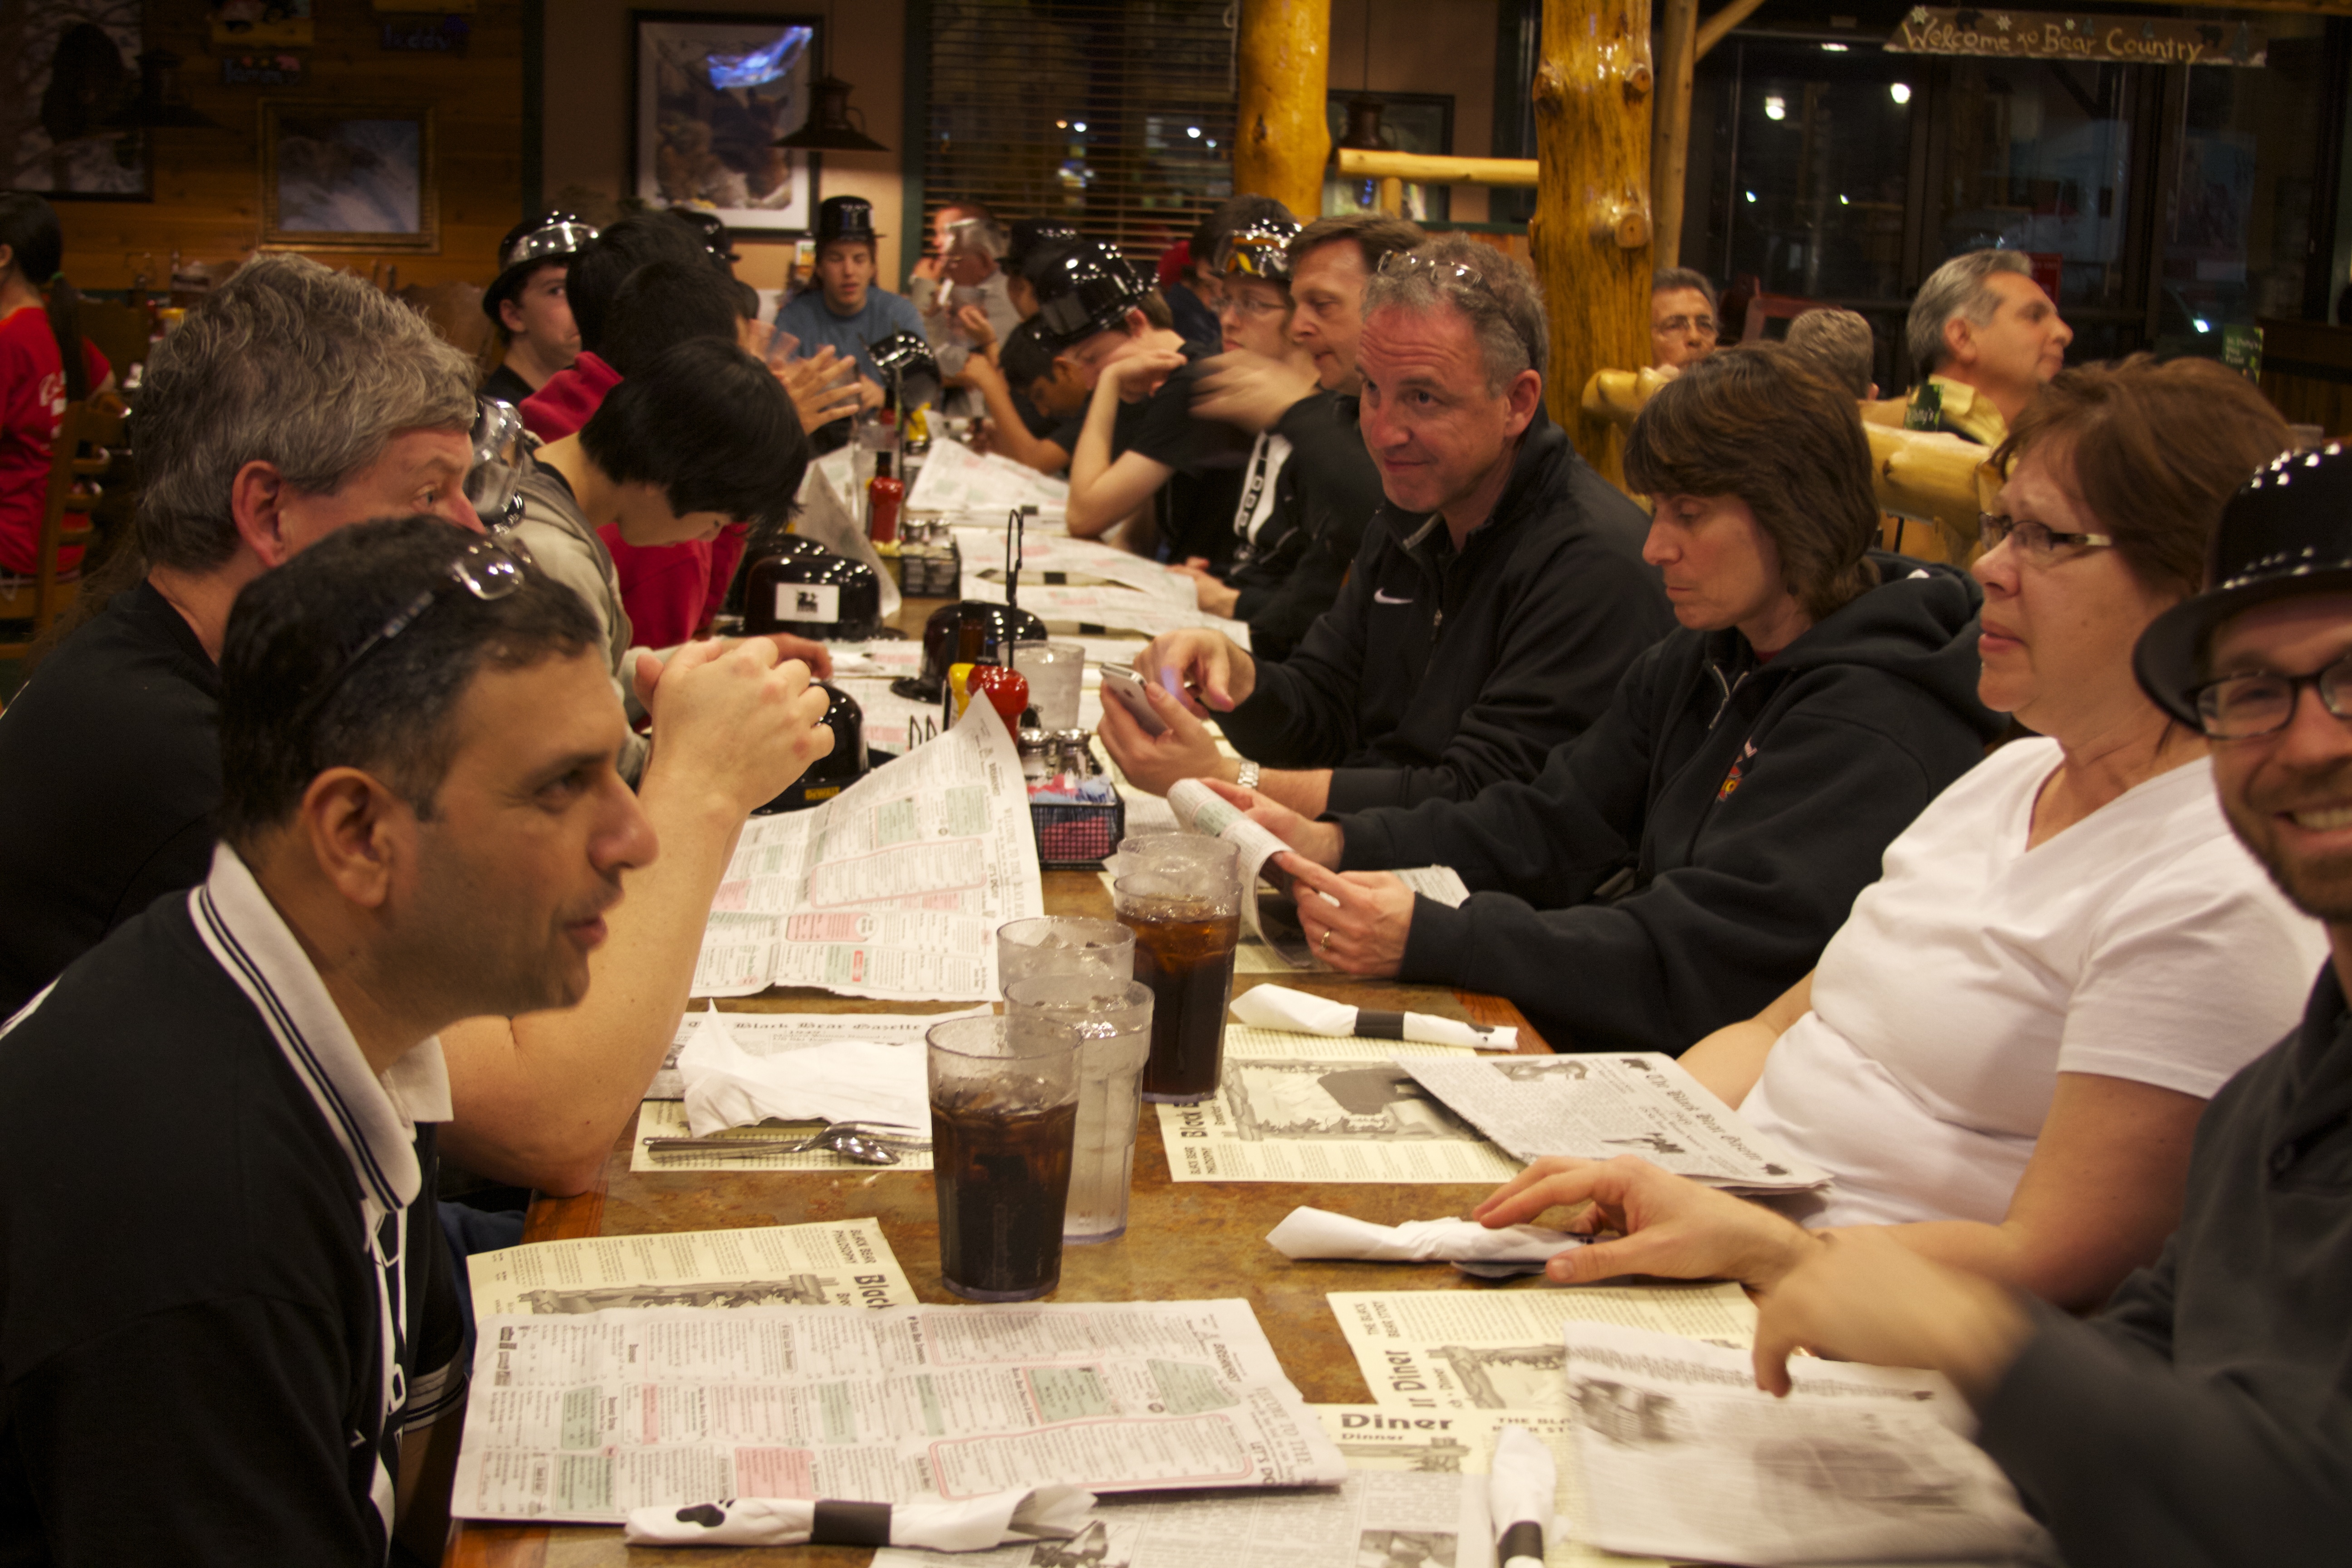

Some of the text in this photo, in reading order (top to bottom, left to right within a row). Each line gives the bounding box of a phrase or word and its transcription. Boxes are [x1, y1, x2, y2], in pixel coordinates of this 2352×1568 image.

[1901, 18, 2205, 65] Welcome to Bear Country
[1176, 1110, 1208, 1138] Black
[1385, 1349, 1428, 1392] Diner
[1341, 1413, 1453, 1430] Diner
[1342, 1433, 1405, 1441] Dinner
[1289, 1439, 1315, 1466] THE
